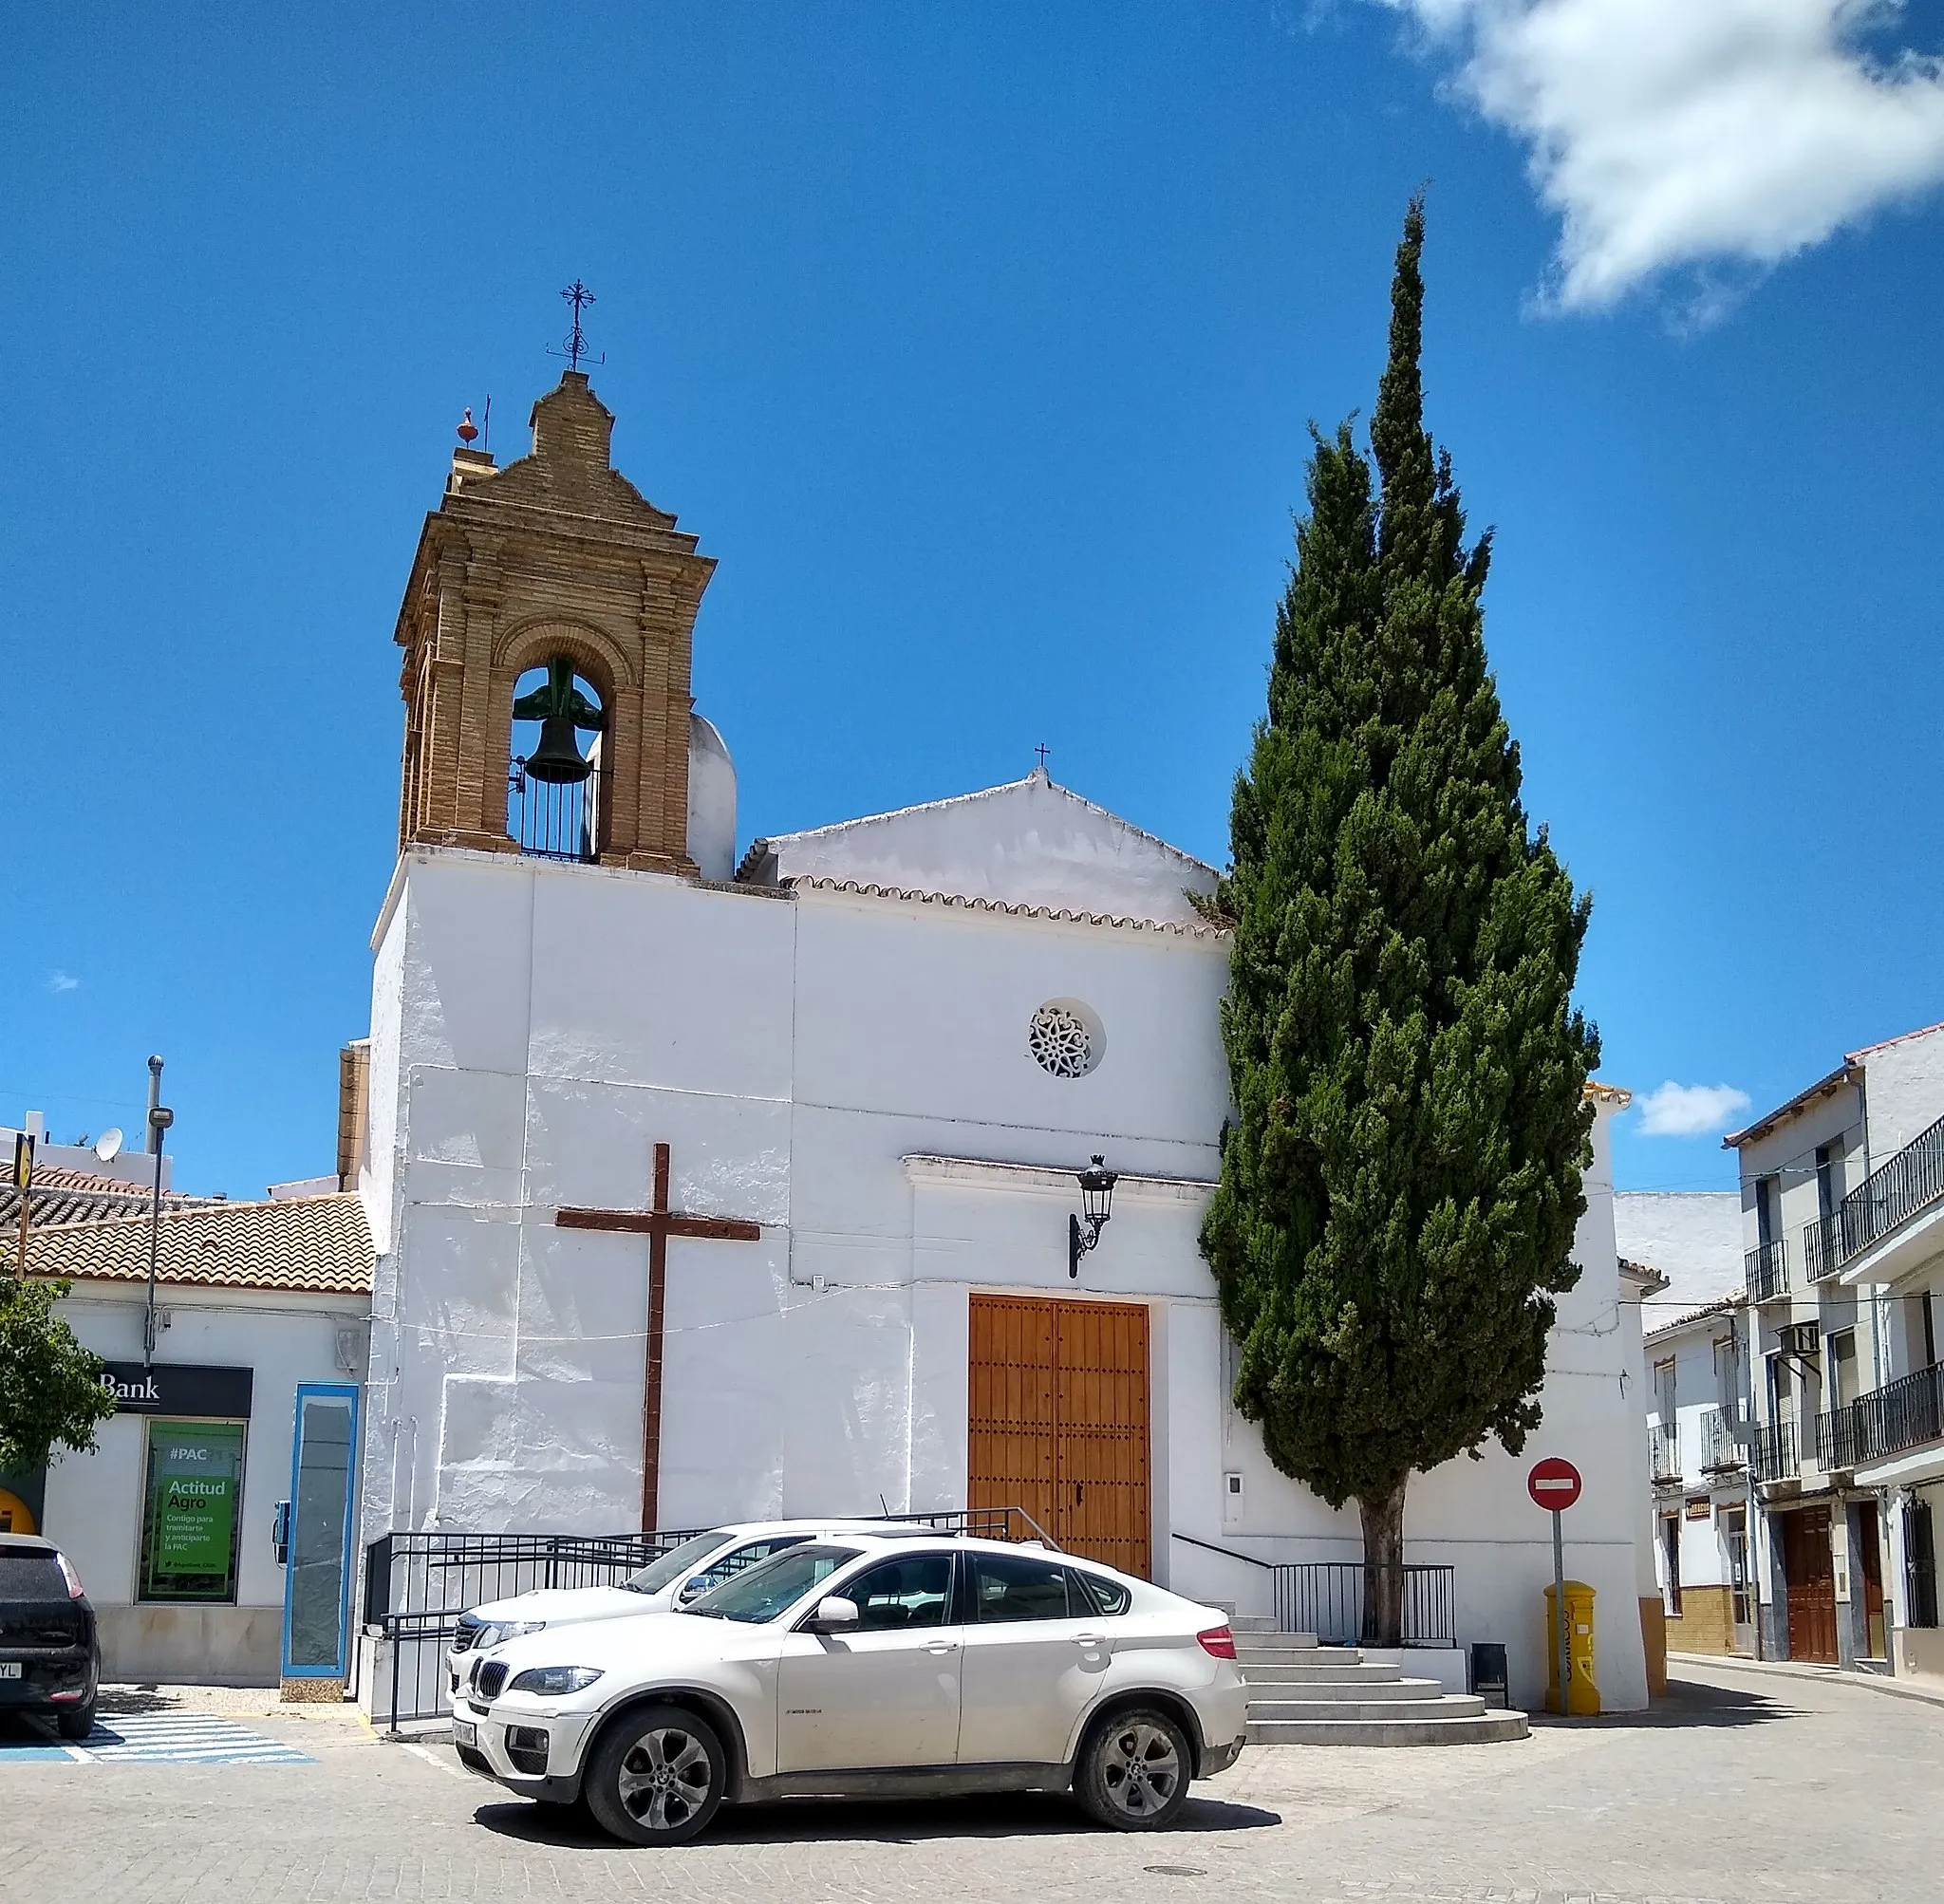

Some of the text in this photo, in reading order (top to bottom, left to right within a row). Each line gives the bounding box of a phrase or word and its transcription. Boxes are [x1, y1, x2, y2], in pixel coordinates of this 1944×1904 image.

[170, 1447, 207, 1461] #PAC
[169, 1481, 226, 1495] Actitud
[168, 1495, 206, 1511] Agro
[166, 1514, 214, 1524] Contigo para
